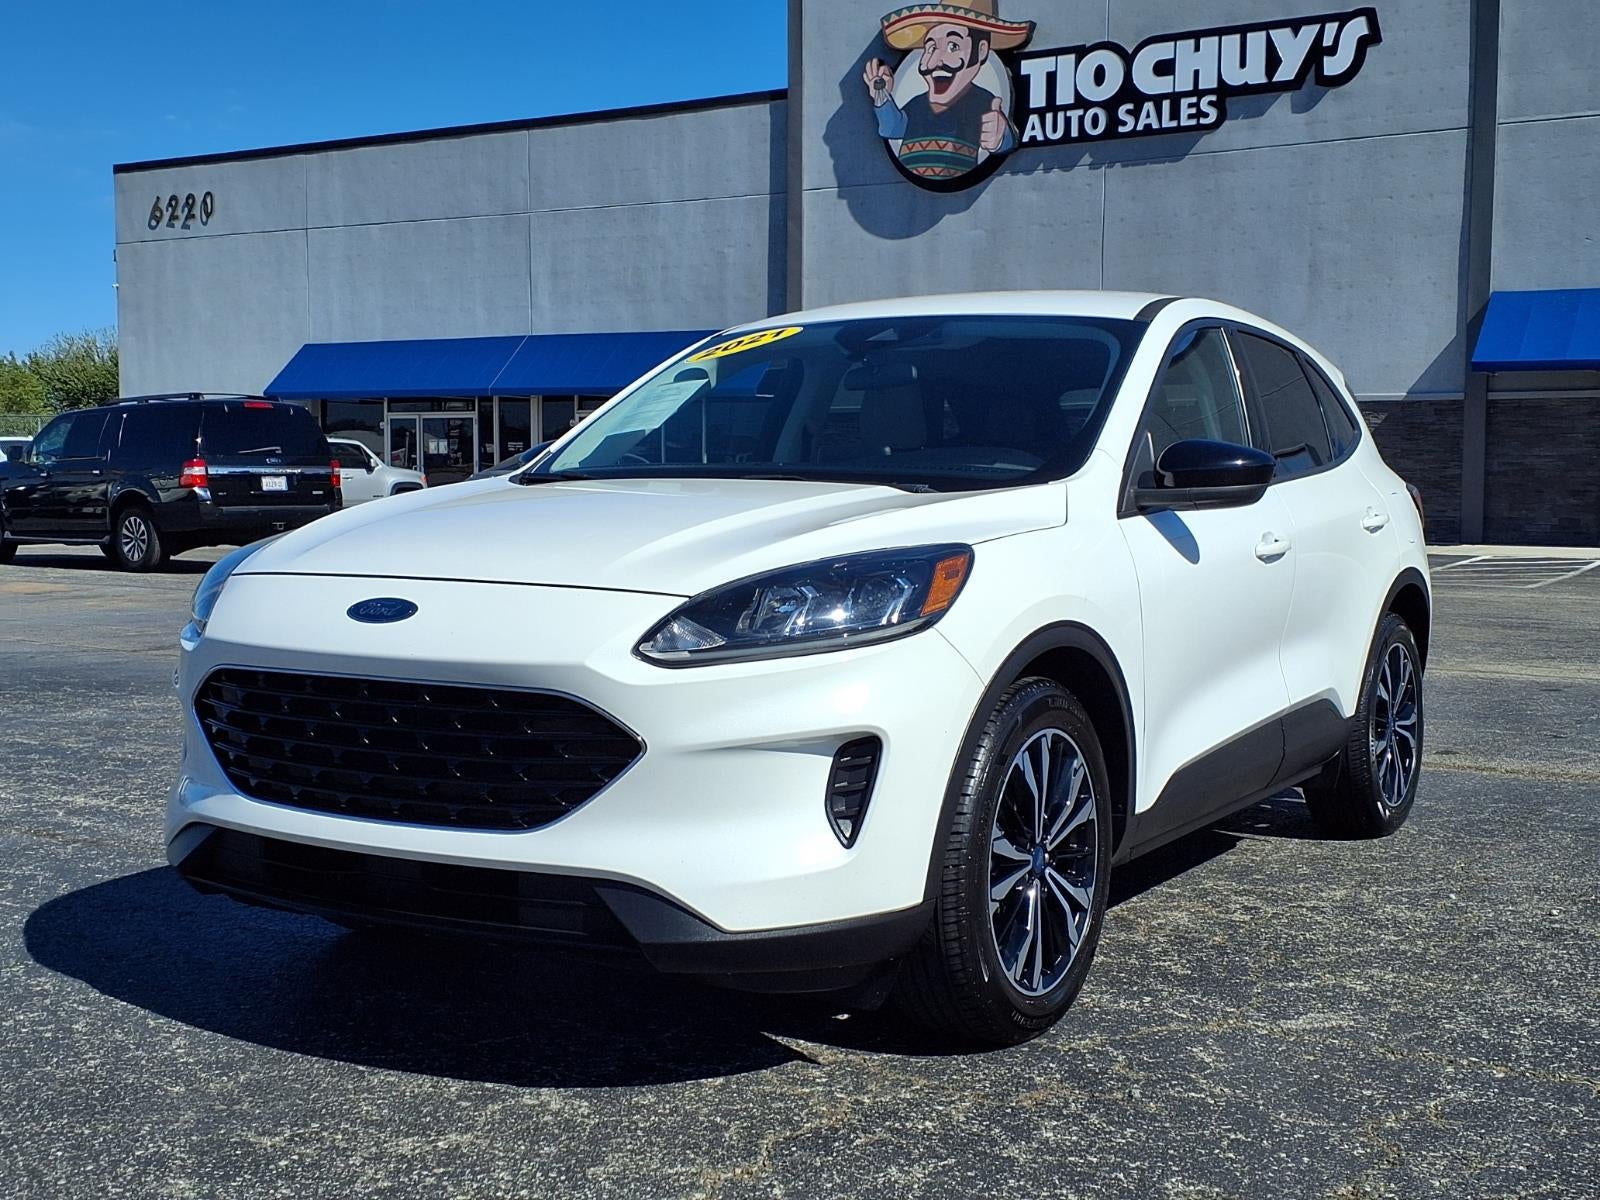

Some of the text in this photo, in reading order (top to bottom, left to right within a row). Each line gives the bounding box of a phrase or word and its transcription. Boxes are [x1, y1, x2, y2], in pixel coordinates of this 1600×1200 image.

[1021, 16, 1369, 108] TIO CHUY'S
[1022, 95, 1218, 143] AUTO SALES
[147, 191, 213, 230] 6220
[695, 329, 789, 361] 2021
